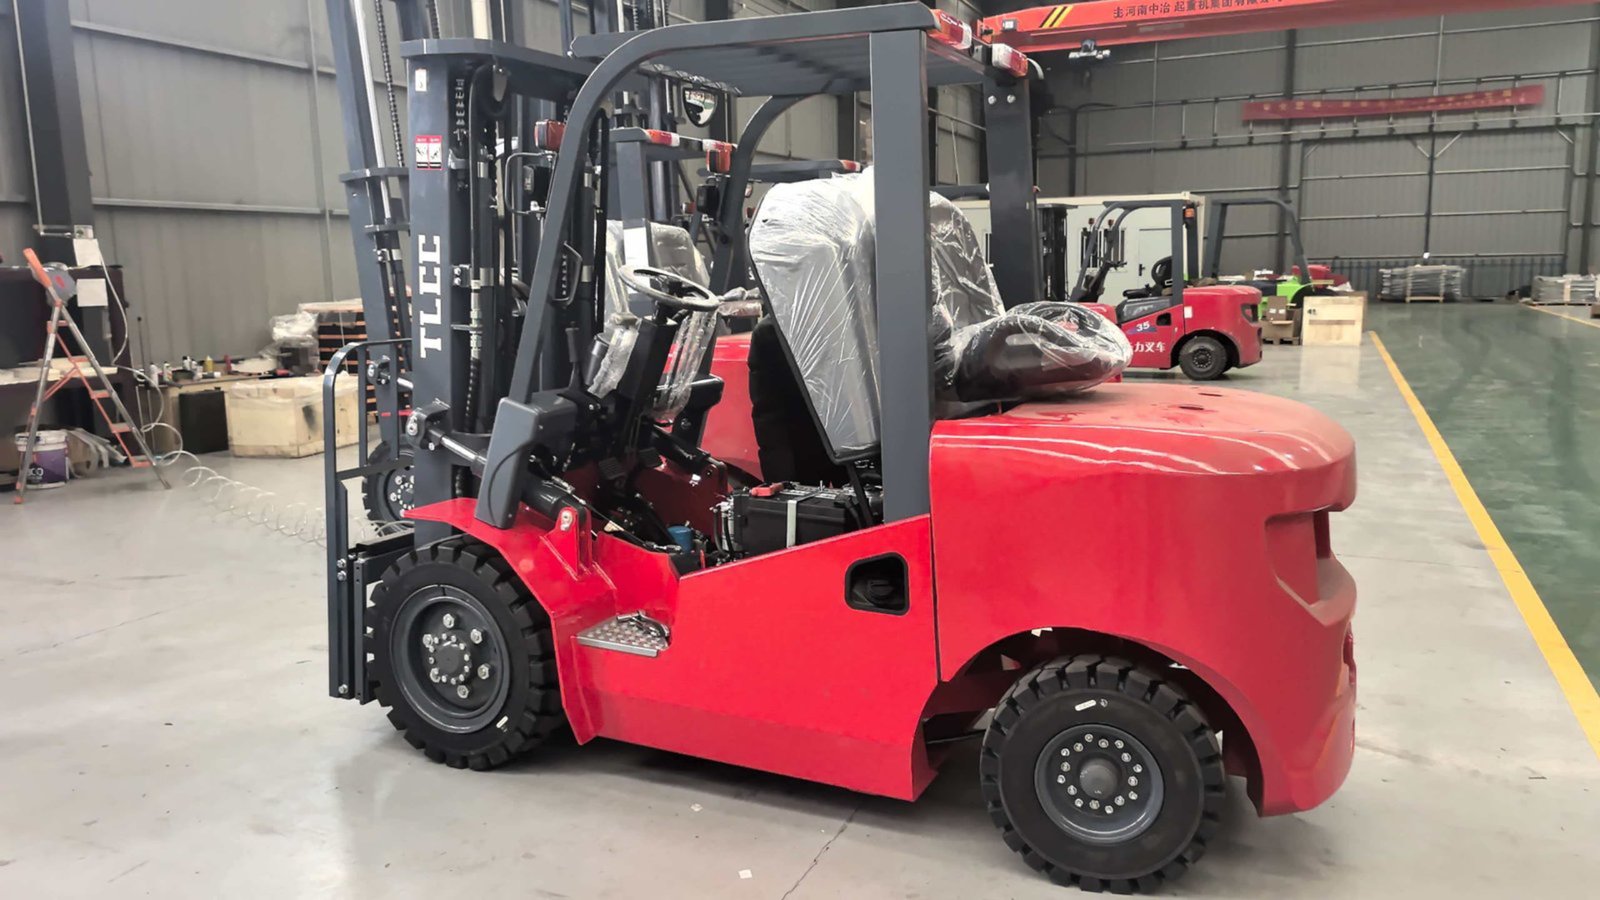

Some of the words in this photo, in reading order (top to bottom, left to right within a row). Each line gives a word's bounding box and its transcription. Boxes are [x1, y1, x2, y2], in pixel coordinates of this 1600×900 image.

[418, 234, 442, 359] TLCC
[1136, 321, 1151, 332] 35
[1130, 341, 1166, 353] 力叉车
